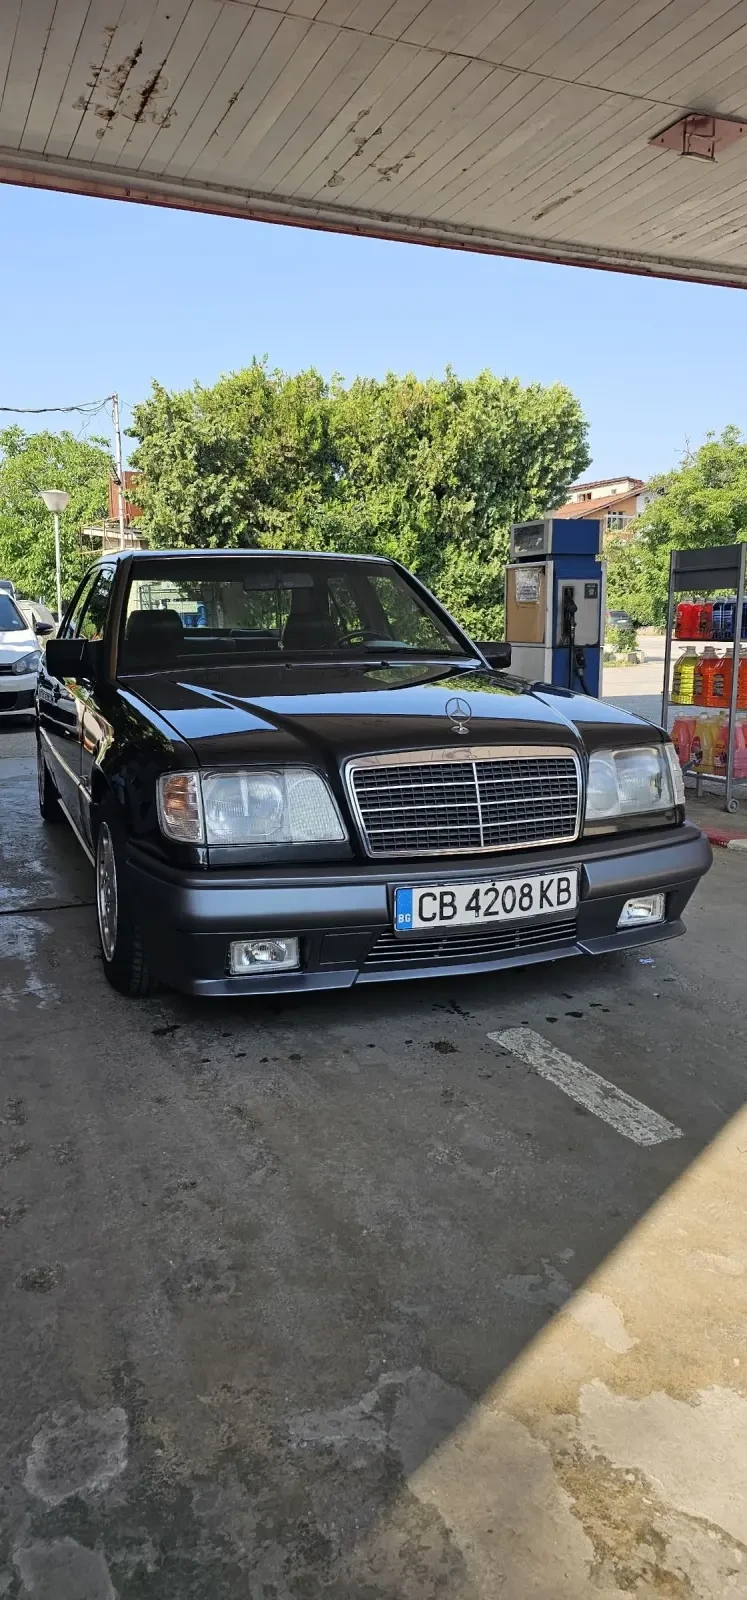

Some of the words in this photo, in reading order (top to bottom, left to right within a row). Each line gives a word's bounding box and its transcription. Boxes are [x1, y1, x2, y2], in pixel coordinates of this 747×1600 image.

[418, 891, 457, 922] CB
[465, 883, 533, 918] 4208
[539, 877, 572, 909] KB
[398, 913, 411, 923] BG
